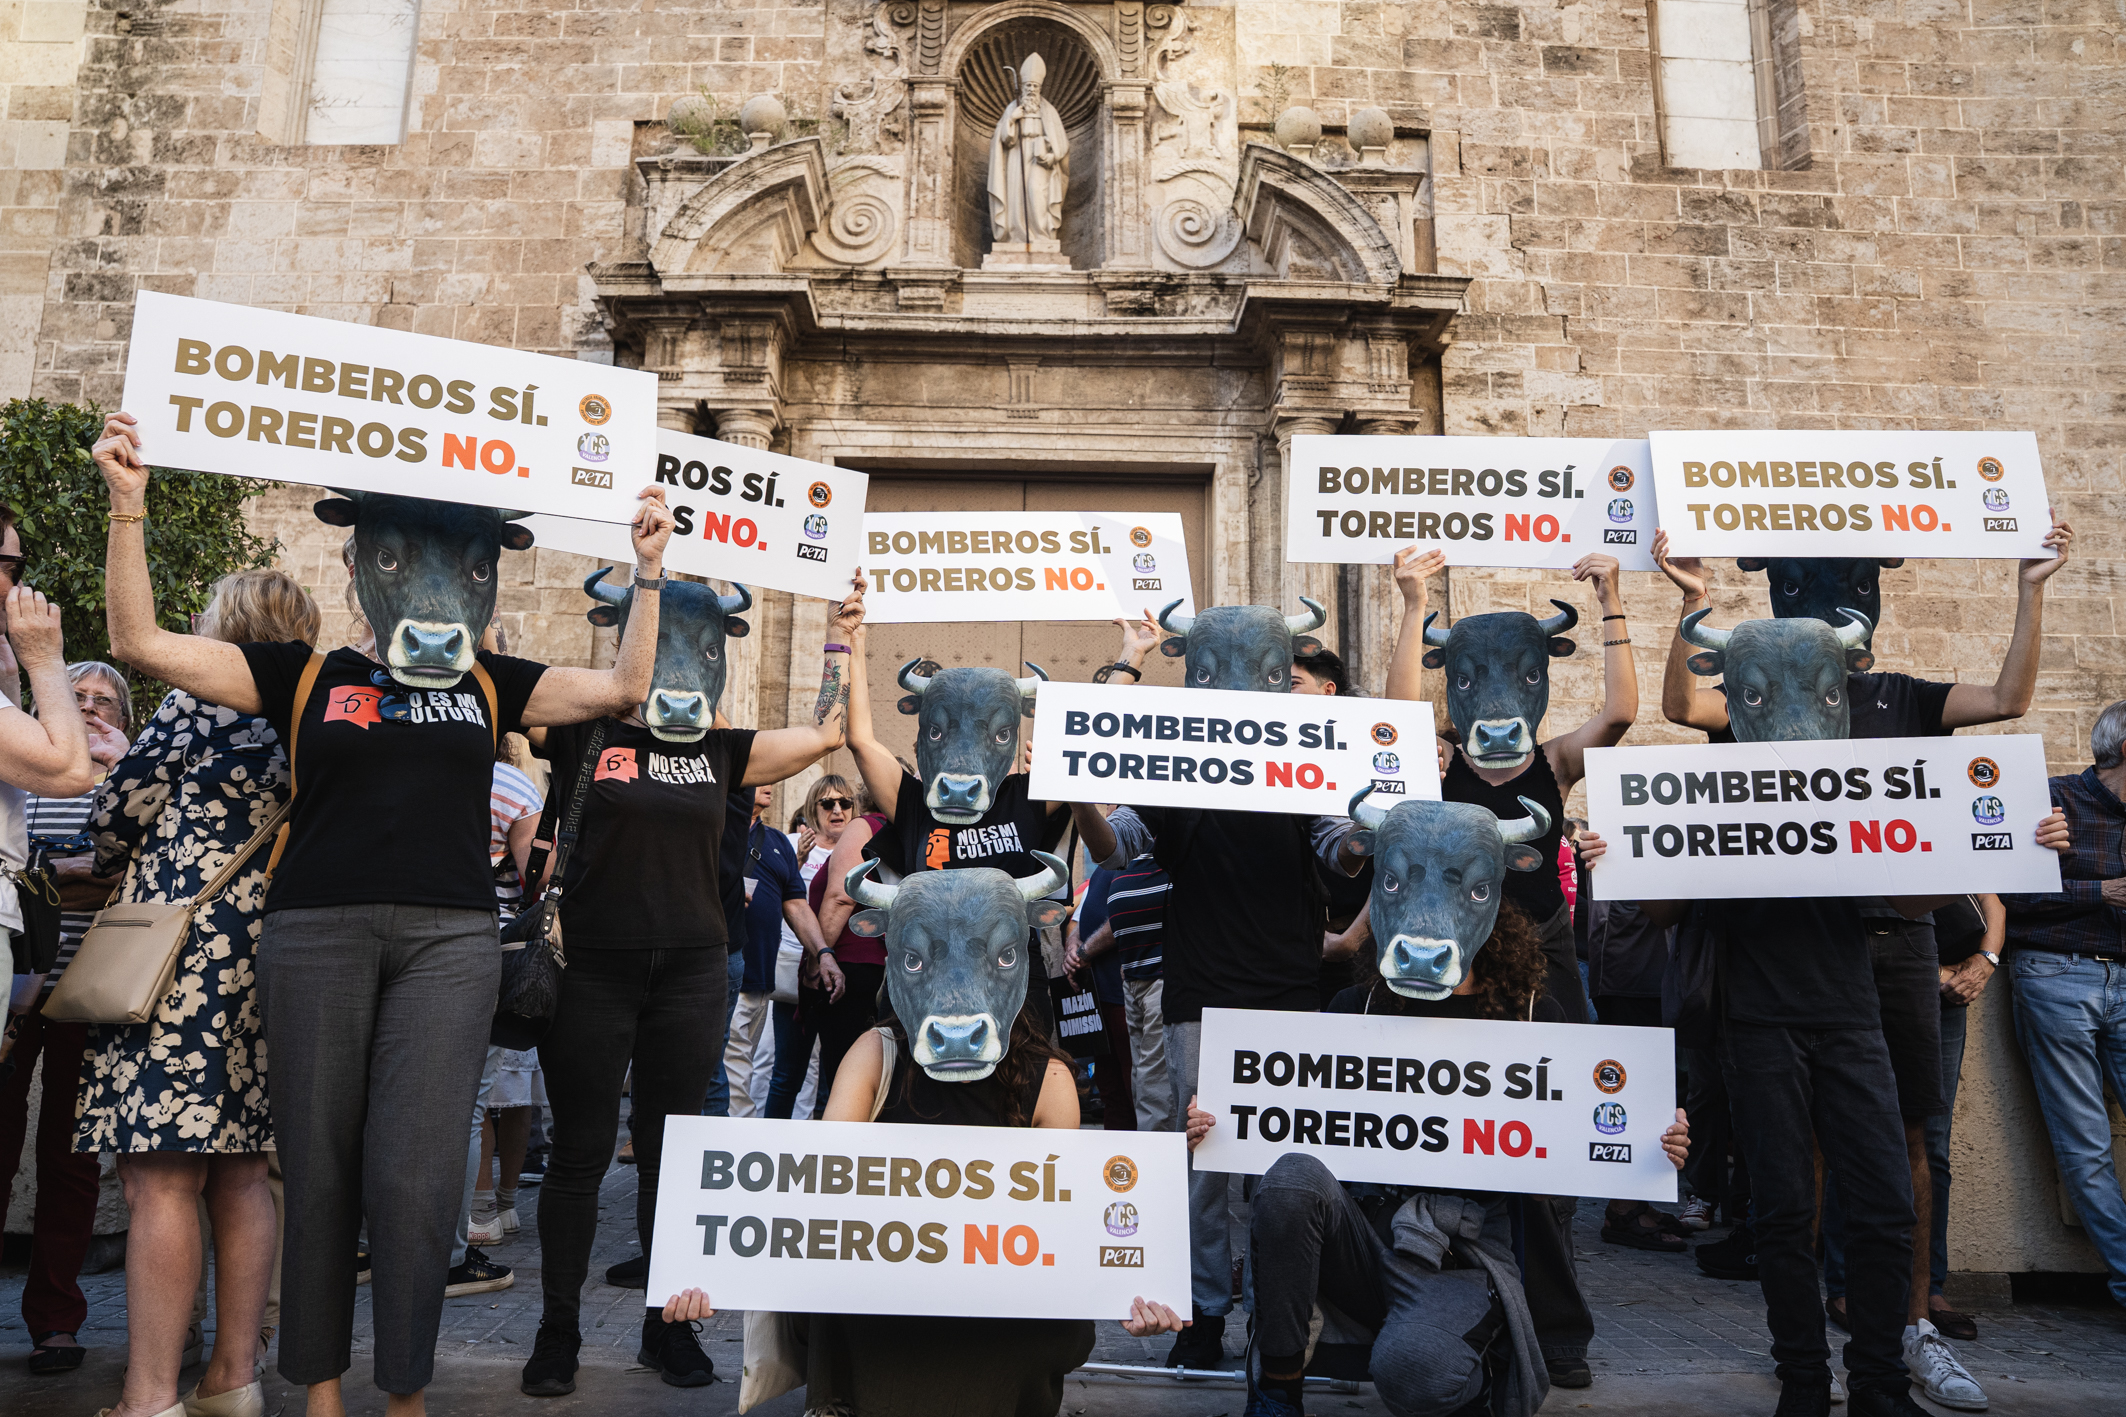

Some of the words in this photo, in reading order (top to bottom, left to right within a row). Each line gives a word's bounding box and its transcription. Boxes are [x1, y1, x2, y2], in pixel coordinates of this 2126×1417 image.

[175, 338, 475, 414] BOMBEROS
[488, 384, 548, 426] SÍ.
[169, 395, 427, 463] TOREROS
[442, 433, 529, 478] NO.
[583, 435, 606, 454] YCS
[655, 453, 733, 495] ROS
[740, 471, 784, 508] SÍ.
[1319, 467, 1527, 497] BOMBEROS
[1537, 465, 1584, 498] SÍ.
[1683, 461, 1898, 488] BOMBEROS
[1908, 457, 1956, 489] SÍ.
[1612, 501, 1631, 516] YCS
[1985, 491, 2006, 505] YCS
[704, 511, 767, 551] NO.
[808, 516, 826, 533] YCS
[1317, 510, 1493, 540] TOREROS
[1505, 514, 1571, 542] NO.
[1687, 504, 1872, 531] TOREROS
[1881, 504, 1951, 532] NO.
[868, 531, 1061, 554] BOMBEROS
[1070, 526, 1111, 554] SÍ.
[1135, 555, 1153, 567] YCS
[869, 568, 1035, 592] TOREROS
[1045, 568, 1104, 591] NO.
[427, 691, 452, 707] ES
[454, 693, 480, 710] MI
[411, 706, 486, 729] ULTURA
[1065, 711, 1288, 746] BOMBEROS
[1298, 719, 1347, 750] SÍ.
[1063, 750, 1254, 785] TOREROS
[1266, 761, 1336, 790] NO.
[1376, 754, 1397, 768] YCS
[648, 766, 717, 785] CULTURA
[1621, 768, 1872, 805] BOMBEROS
[1884, 759, 1941, 799] SÍ.
[1976, 799, 2000, 816] YCS
[1978, 816, 2002, 824] VALENCIA
[956, 836, 1024, 860] CULTURA
[1623, 820, 1837, 857] TOREROS
[1849, 819, 1932, 853] NO.
[1061, 988, 1096, 1016] MAZÓN
[1059, 1009, 1103, 1038] DIMISSIÓ
[1233, 1050, 1491, 1097] BOMBEROS
[1503, 1057, 1562, 1101] SÍ.
[1598, 1125, 1623, 1133] VALENCIA
[1599, 1106, 1622, 1125] YCS
[1230, 1105, 1449, 1152] TOREROS
[1463, 1119, 1547, 1158] NO.
[701, 1150, 994, 1199] BOMBEROS
[1008, 1154, 1071, 1202] SÍ.
[1110, 1206, 1134, 1226] YCS
[469, 1232, 490, 1241] Kappa
[696, 1215, 948, 1263] TOREROS
[964, 1224, 1054, 1266] NO.
[1110, 1227, 1135, 1235] VALENCIA
